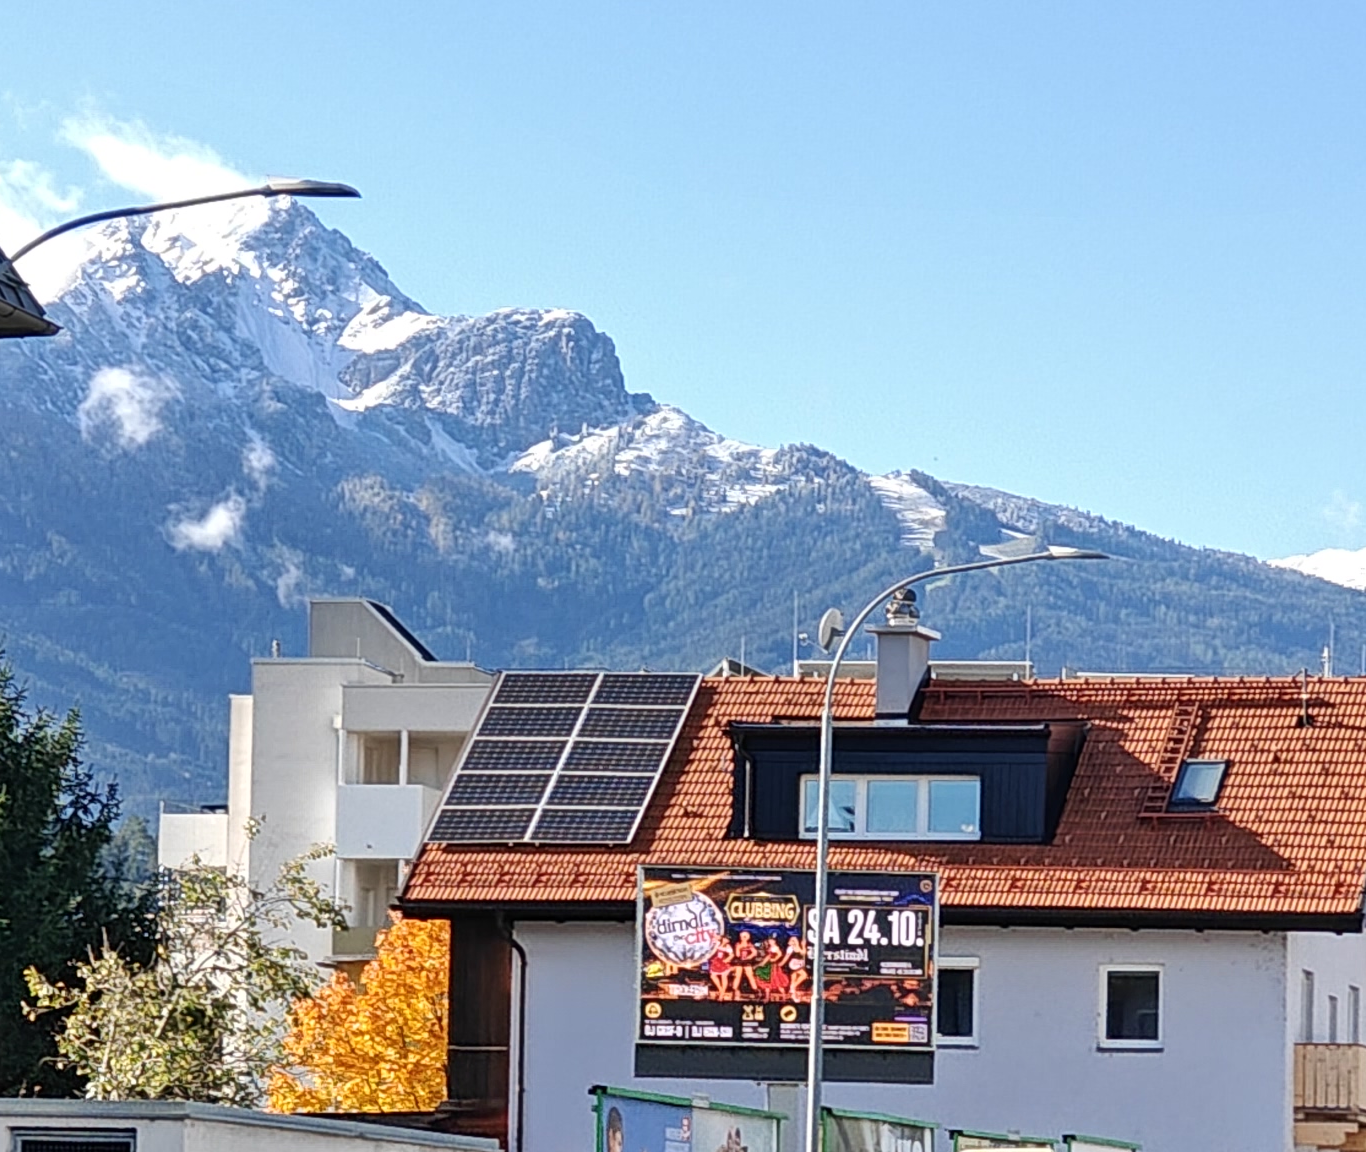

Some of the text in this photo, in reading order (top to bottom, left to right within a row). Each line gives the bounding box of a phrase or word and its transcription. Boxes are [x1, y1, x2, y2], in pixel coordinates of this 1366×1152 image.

[730, 901, 795, 920] CLUBBING
[807, 908, 924, 947] SA 24.10.
